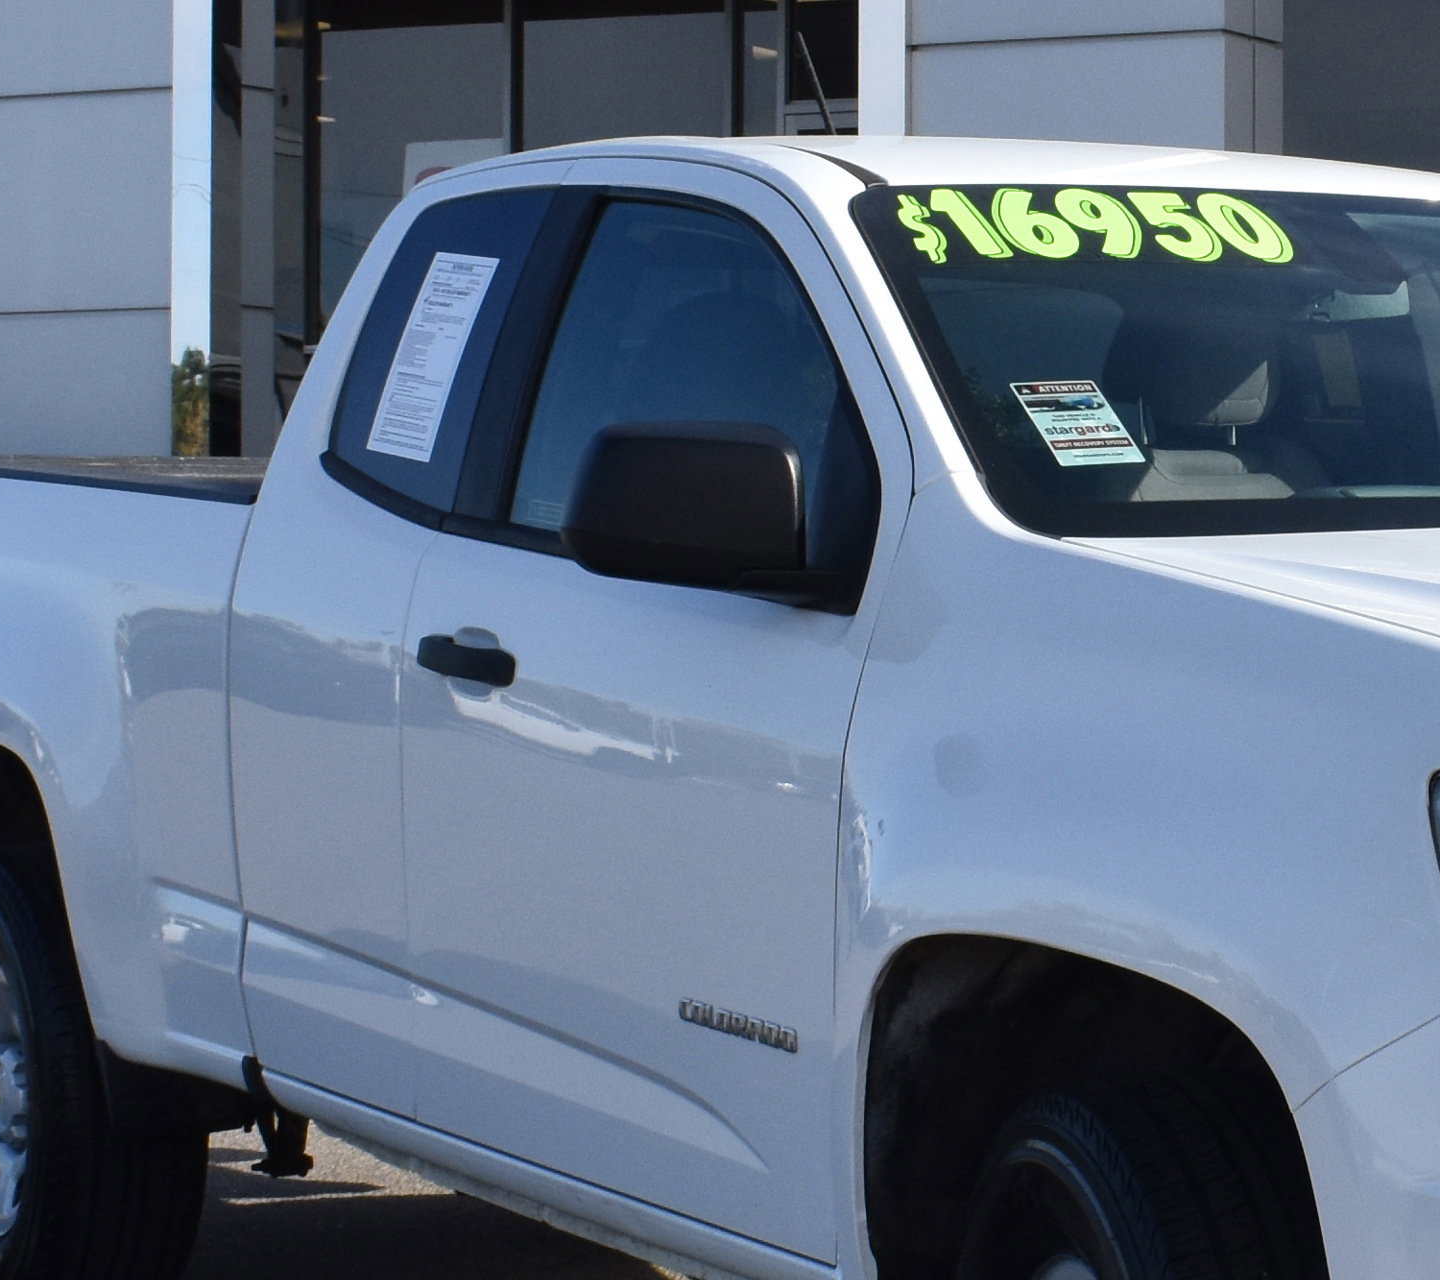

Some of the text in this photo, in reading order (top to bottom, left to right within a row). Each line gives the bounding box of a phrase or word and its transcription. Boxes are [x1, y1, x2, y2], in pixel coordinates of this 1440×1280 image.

[896, 187, 1295, 265] $16950
[1039, 383, 1093, 393] ATTENTION
[1044, 422, 1114, 436] stargard
[678, 996, 799, 1054] COLORADO
